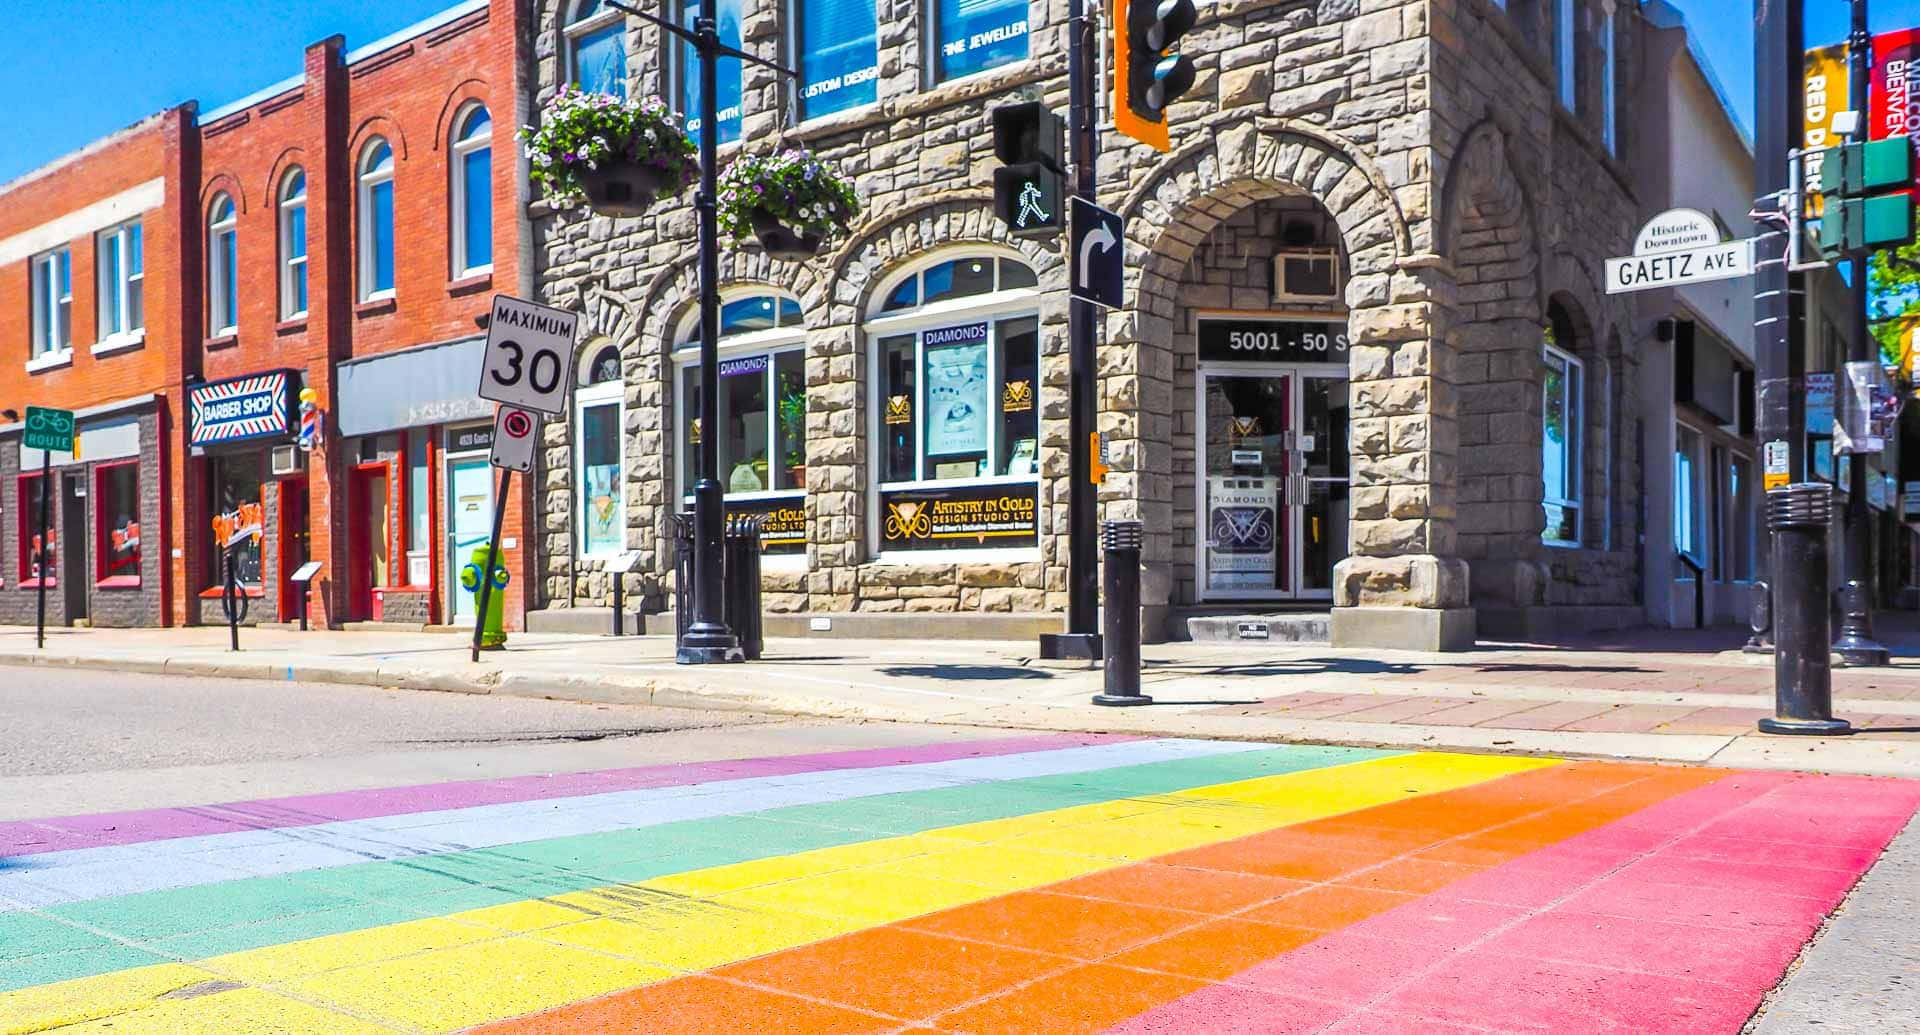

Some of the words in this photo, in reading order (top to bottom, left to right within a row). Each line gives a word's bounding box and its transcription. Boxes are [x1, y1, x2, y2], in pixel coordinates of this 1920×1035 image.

[943, 39, 967, 56] FINE
[969, 21, 1028, 49] JEWELLER
[799, 76, 842, 99] CUSTOM
[1806, 74, 1827, 124] RED
[1651, 221, 1700, 237] Historic
[1644, 232, 1708, 250] Downtown
[1619, 254, 1694, 286] GAETZ
[1703, 250, 1737, 271] AVE
[496, 305, 571, 338] MAXIMUM
[925, 324, 986, 345] DIAMONDS
[1229, 331, 1281, 351] 5001
[1302, 332, 1329, 352] 50
[491, 340, 562, 394] 30
[720, 356, 768, 375] DIAMONDS
[203, 400, 242, 422] BARBER
[243, 395, 272, 415] SHOP
[28, 433, 69, 448] ROUTE
[778, 508, 805, 521] GOLD
[932, 499, 984, 515] ARTISTRY
[985, 499, 997, 513] IN
[998, 496, 1034, 512] GOLD
[760, 522, 787, 531] TUDIO
[789, 521, 805, 530] LTD
[932, 514, 968, 524] DESIGN
[971, 512, 1010, 523] STUDIO
[1013, 511, 1034, 521] LTD
